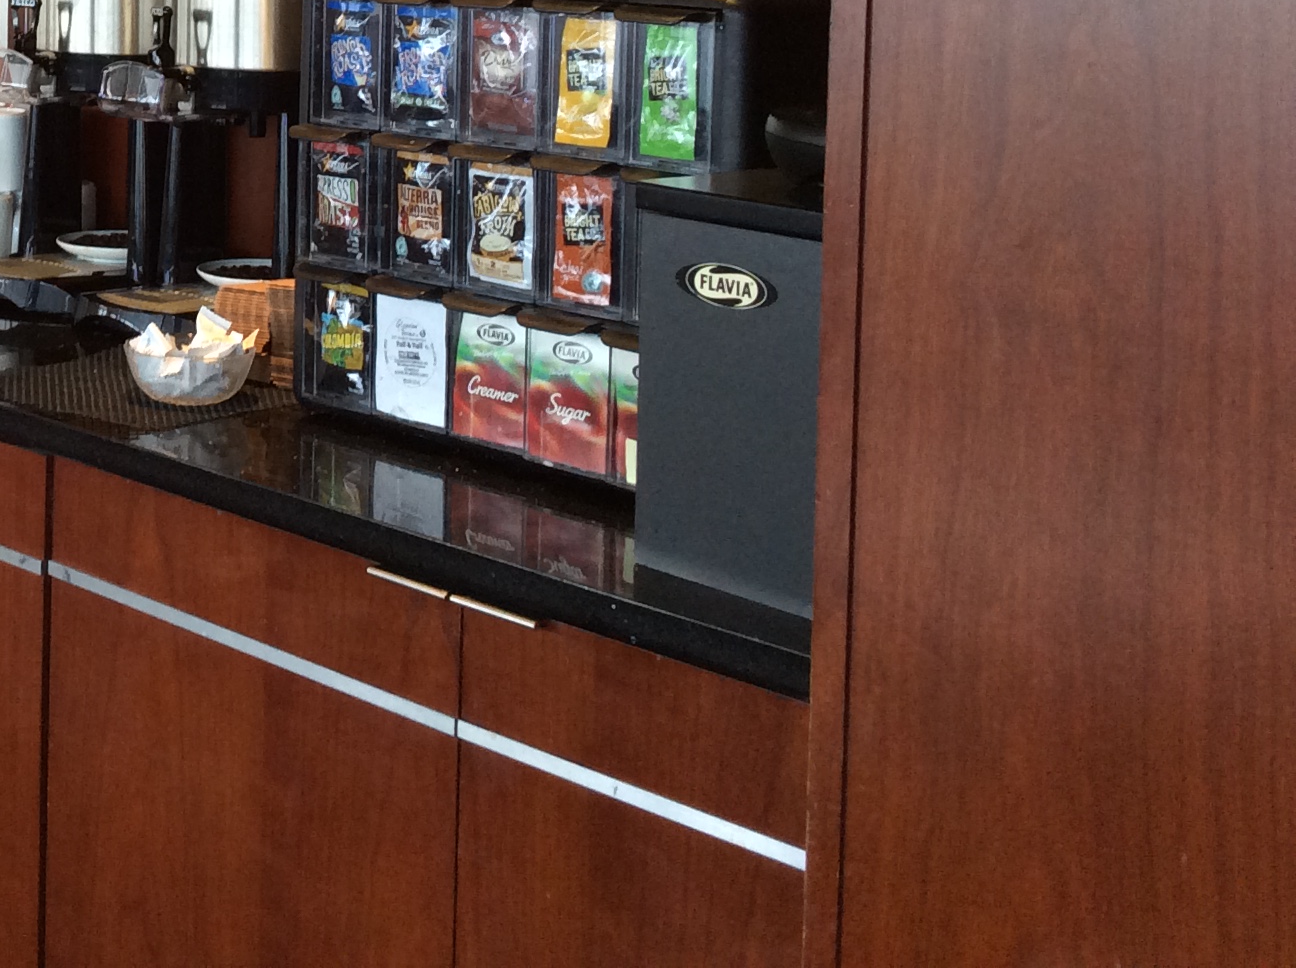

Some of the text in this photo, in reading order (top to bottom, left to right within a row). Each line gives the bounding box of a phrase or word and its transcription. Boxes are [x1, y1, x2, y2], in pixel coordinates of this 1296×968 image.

[650, 69, 683, 83] BRIT
[566, 228, 585, 241] TEA
[700, 274, 752, 298] FLAVIA
[482, 328, 509, 342] FLAVIA
[558, 346, 586, 360] FLAVIA
[467, 375, 519, 403] Creamer
[545, 393, 591, 425] Sugar
